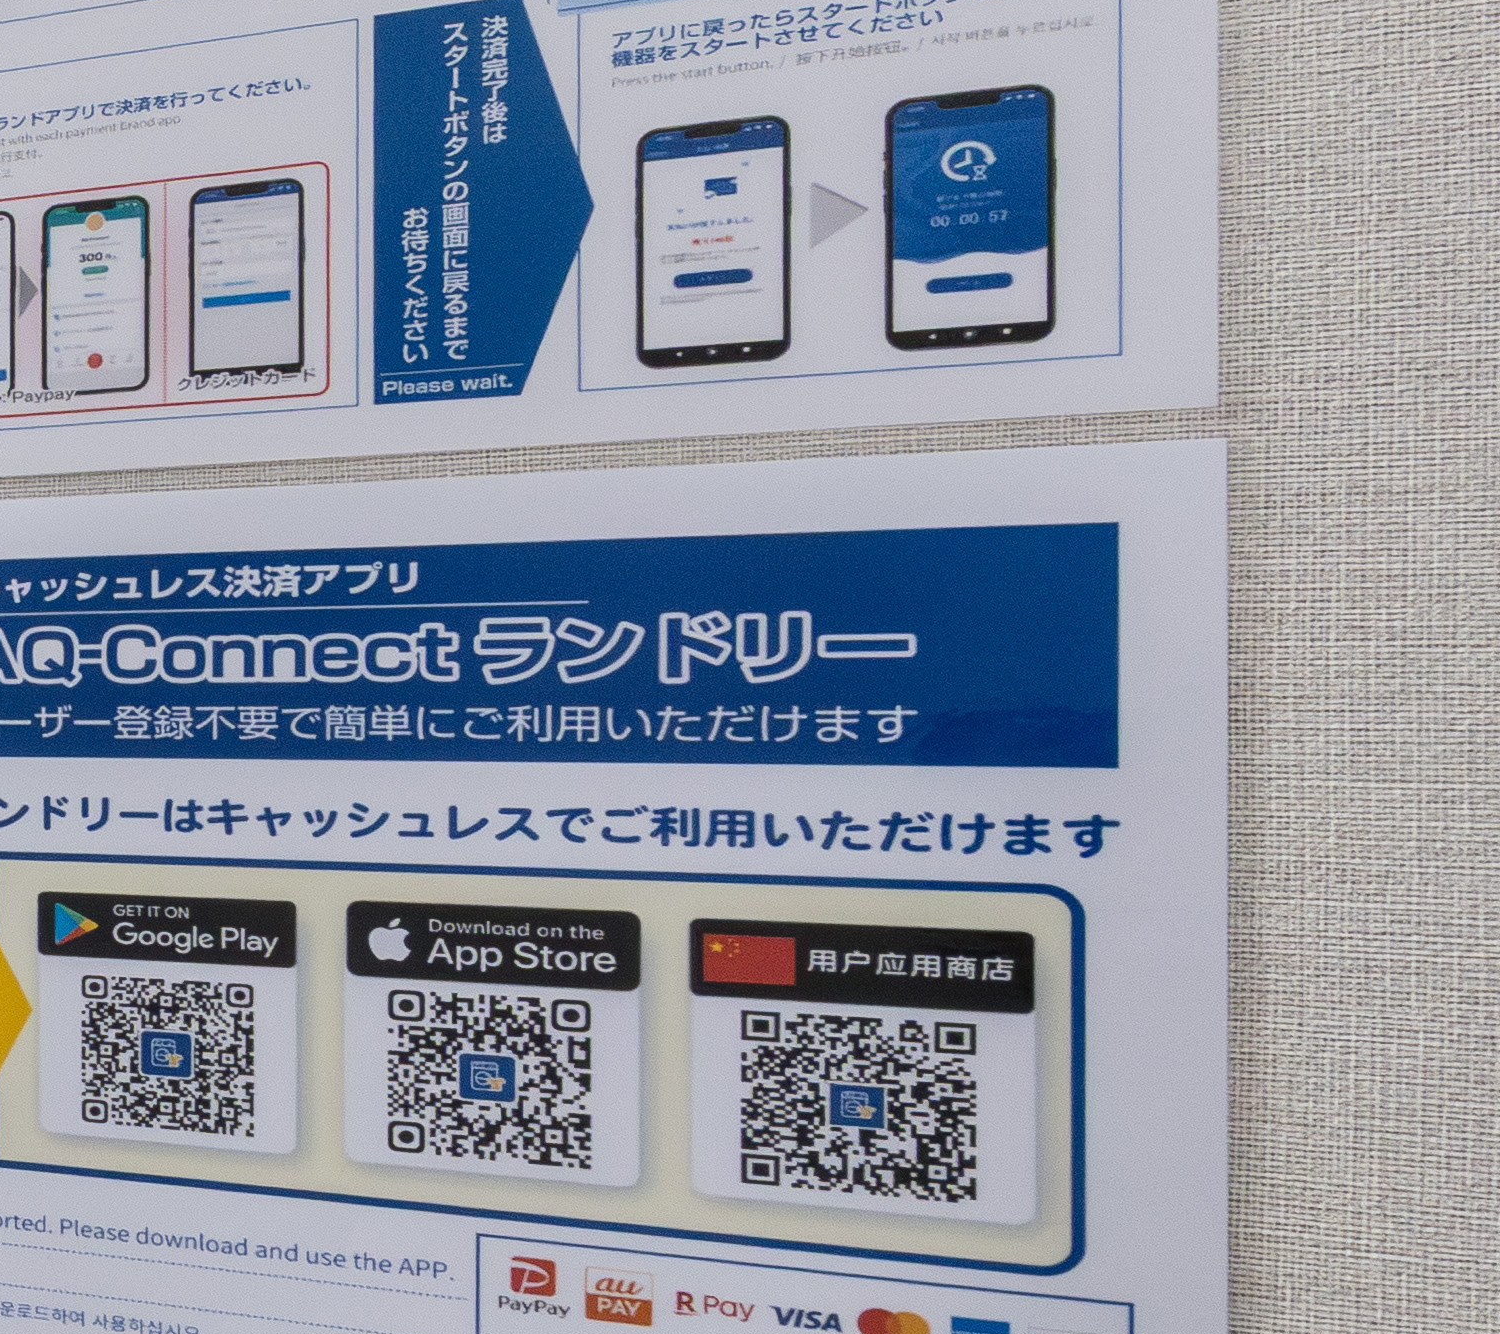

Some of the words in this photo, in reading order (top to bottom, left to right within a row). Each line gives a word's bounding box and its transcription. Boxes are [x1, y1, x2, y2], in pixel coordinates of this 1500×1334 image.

[610, 9, 944, 68] 機器をスタートさせてください
[481, 14, 510, 144] 決済完了後は
[610, 73, 650, 88] Press
[651, 70, 679, 82] the
[681, 66, 713, 80] start
[65, 123, 118, 140] payment
[442, 22, 469, 360] スタートボタンの画面に戻るまで
[401, 208, 429, 363] お待ちください
[177, 367, 318, 394] クレジットカード
[382, 377, 457, 397] Please
[461, 371, 514, 393] wait.
[473, 609, 918, 685] ランドリー
[112, 903, 146, 920] GET
[149, 904, 162, 920] IT
[165, 905, 190, 921] ON
[112, 920, 214, 955] Google
[219, 925, 280, 959] Play
[428, 918, 531, 938] Download
[537, 924, 563, 939] on
[567, 923, 605, 941] the
[427, 938, 505, 973] App
[512, 940, 618, 974] Store
[806, 947, 1016, 983] 用户应用商店
[58, 1217, 131, 1243] Please
[134, 1226, 249, 1257] download
[254, 1240, 299, 1264] and
[305, 1251, 347, 1269] use
[352, 1252, 393, 1274] the
[397, 1256, 457, 1282] APP.
[594, 1275, 644, 1297] au
[497, 1294, 571, 1319] PayPay
[596, 1297, 643, 1318] PAY
[703, 1294, 756, 1322] Pay
[770, 1304, 843, 1334] VISA
